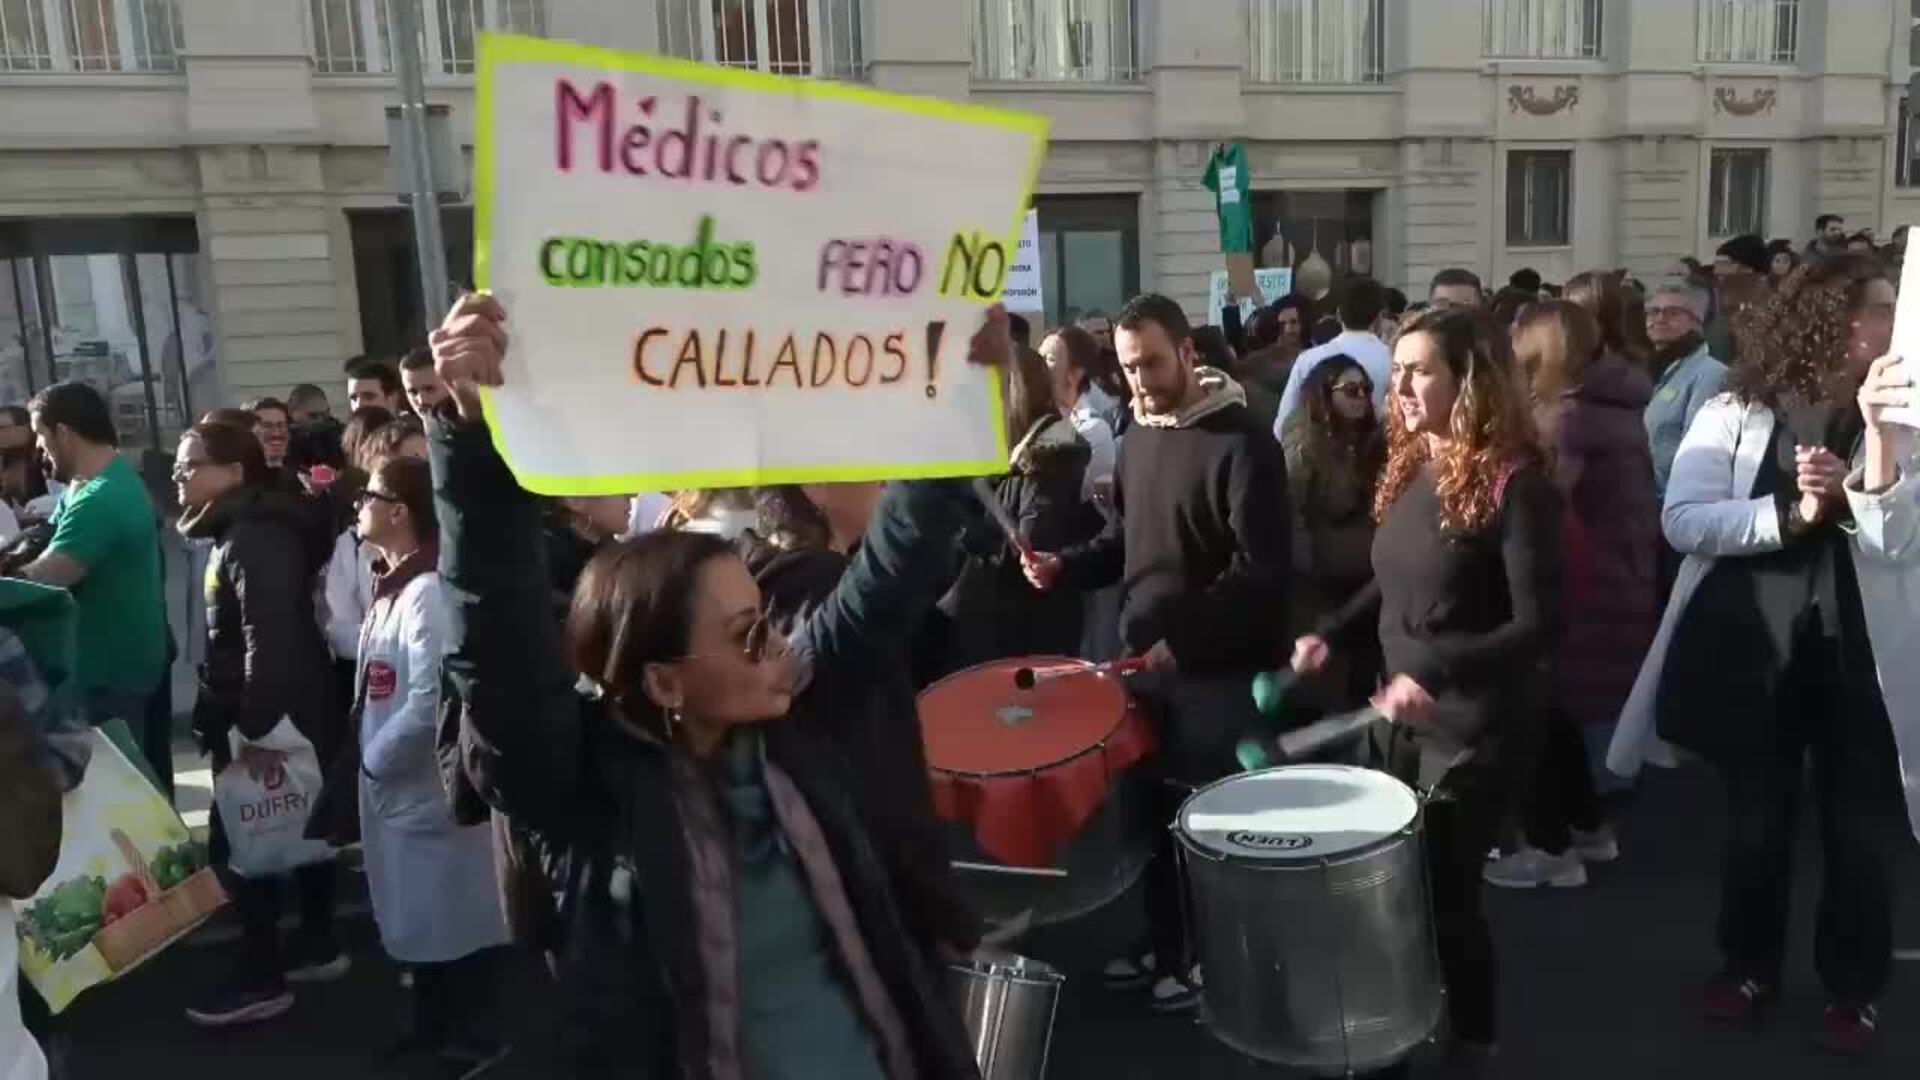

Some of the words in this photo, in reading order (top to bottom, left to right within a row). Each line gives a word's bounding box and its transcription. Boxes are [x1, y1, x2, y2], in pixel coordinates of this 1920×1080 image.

[554, 78, 820, 191] Médicos
[540, 213, 758, 287] cansados
[817, 238, 924, 296] PERO
[939, 228, 1006, 298] NO
[240, 791, 309, 822] DUFRY
[1241, 834, 1298, 847] LUEN
